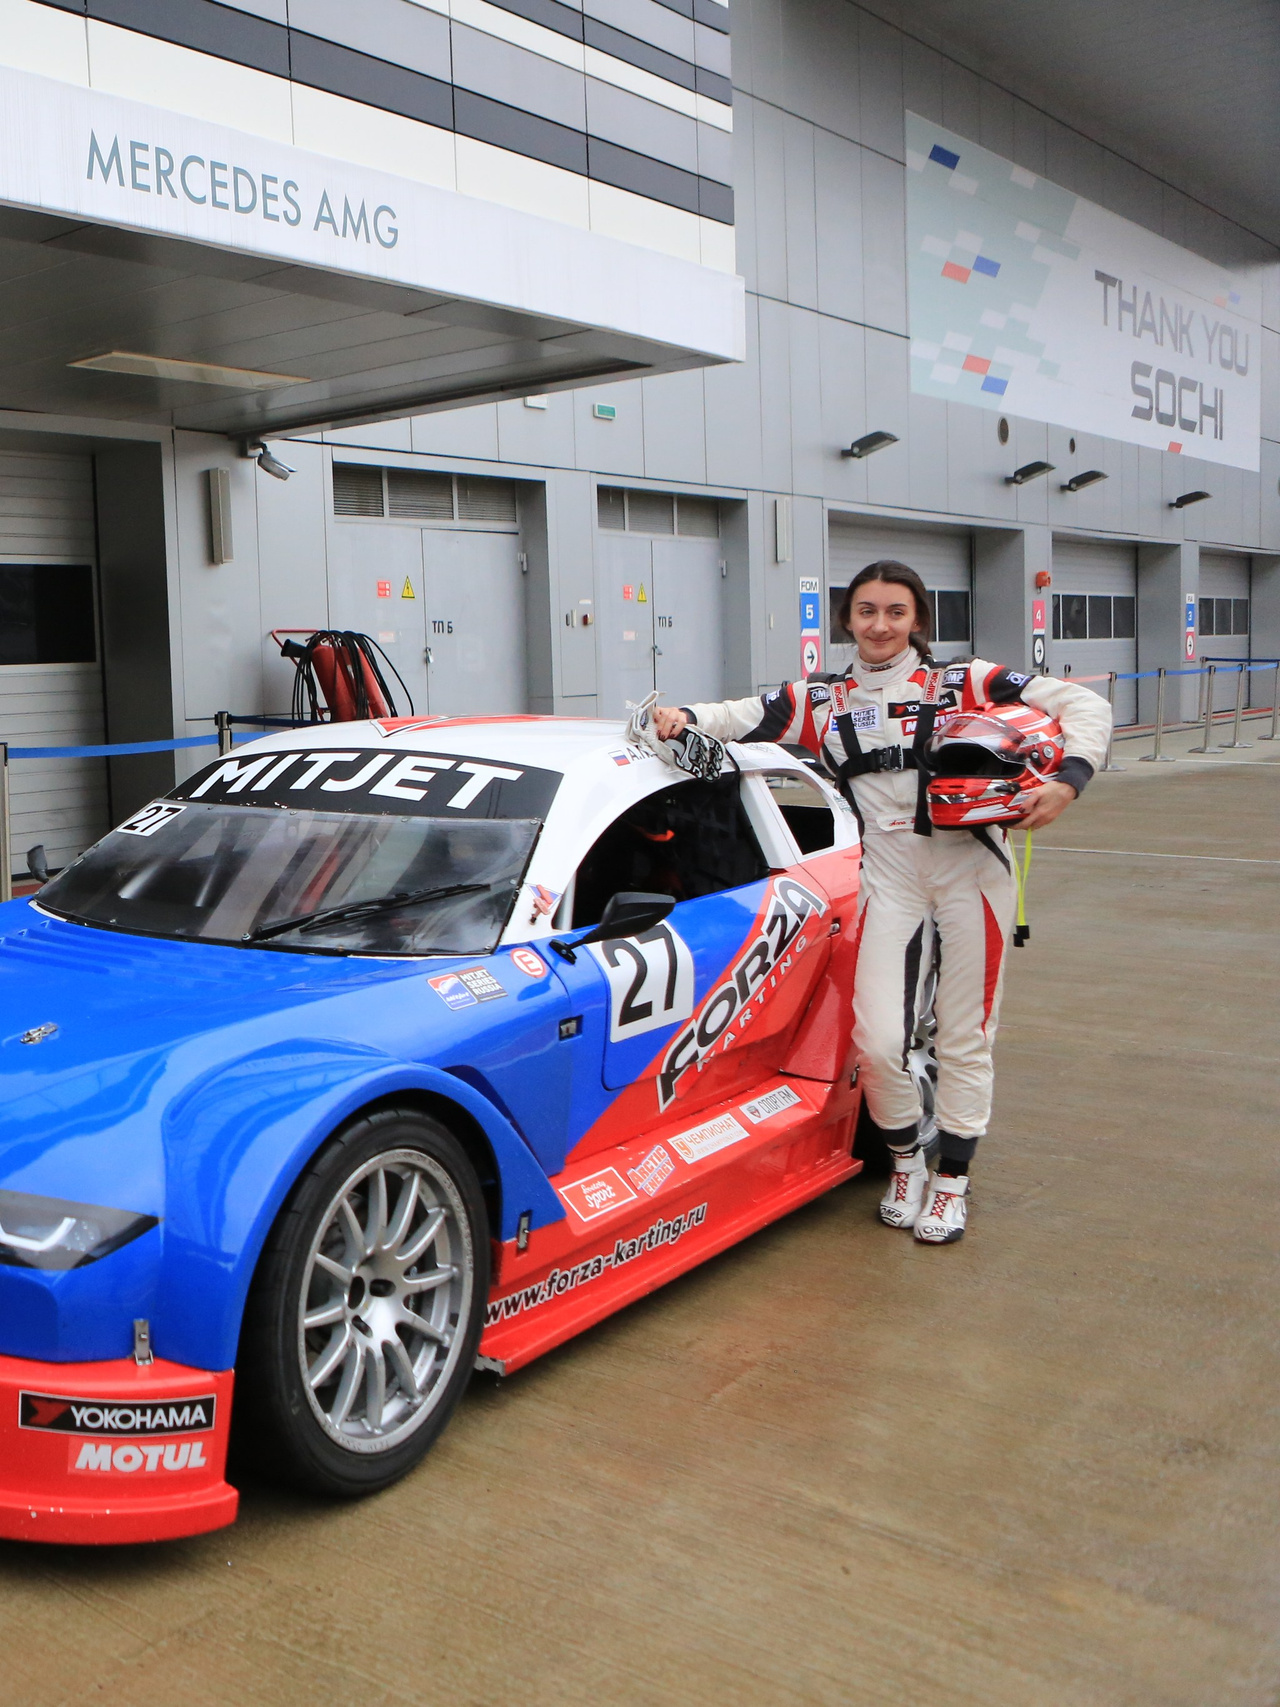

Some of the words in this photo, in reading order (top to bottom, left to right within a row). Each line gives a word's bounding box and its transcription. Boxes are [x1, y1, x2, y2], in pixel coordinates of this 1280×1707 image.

[87, 128, 301, 227] MERCEDES
[313, 188, 399, 249] AMG
[1094, 269, 1195, 358] THANK
[1202, 314, 1249, 377] YOU
[1131, 360, 1224, 441] SOCHI
[801, 580, 818, 591] FOM
[806, 604, 814, 619] 5
[1036, 609, 1041, 622] 4
[837, 685, 846, 712] SIMPSON
[926, 671, 939, 702] SIMPSON
[853, 708, 876, 718] MITJET
[853, 715, 876, 723] SERIES
[189, 752, 524, 810] MITJET
[122, 805, 183, 833] 27
[460, 969, 490, 983] MITJET
[466, 976, 497, 989] SERIES
[472, 983, 503, 996] RUSSIA
[601, 923, 678, 1028] 27
[697, 935, 807, 1072] KARTING
[758, 1094, 780, 1114] СПОРТ
[778, 1089, 797, 1106] FM
[684, 1117, 737, 1146] ЧЕМПИОНАТ
[627, 1147, 667, 1189] ARCTIC
[643, 1159, 675, 1195] ENERGY
[881, 1207, 902, 1220] OMP
[483, 1202, 708, 1328] www.forza-karting.ru
[70, 1404, 207, 1430] YOKOHAMA
[75, 1441, 207, 1472] MOTUL
